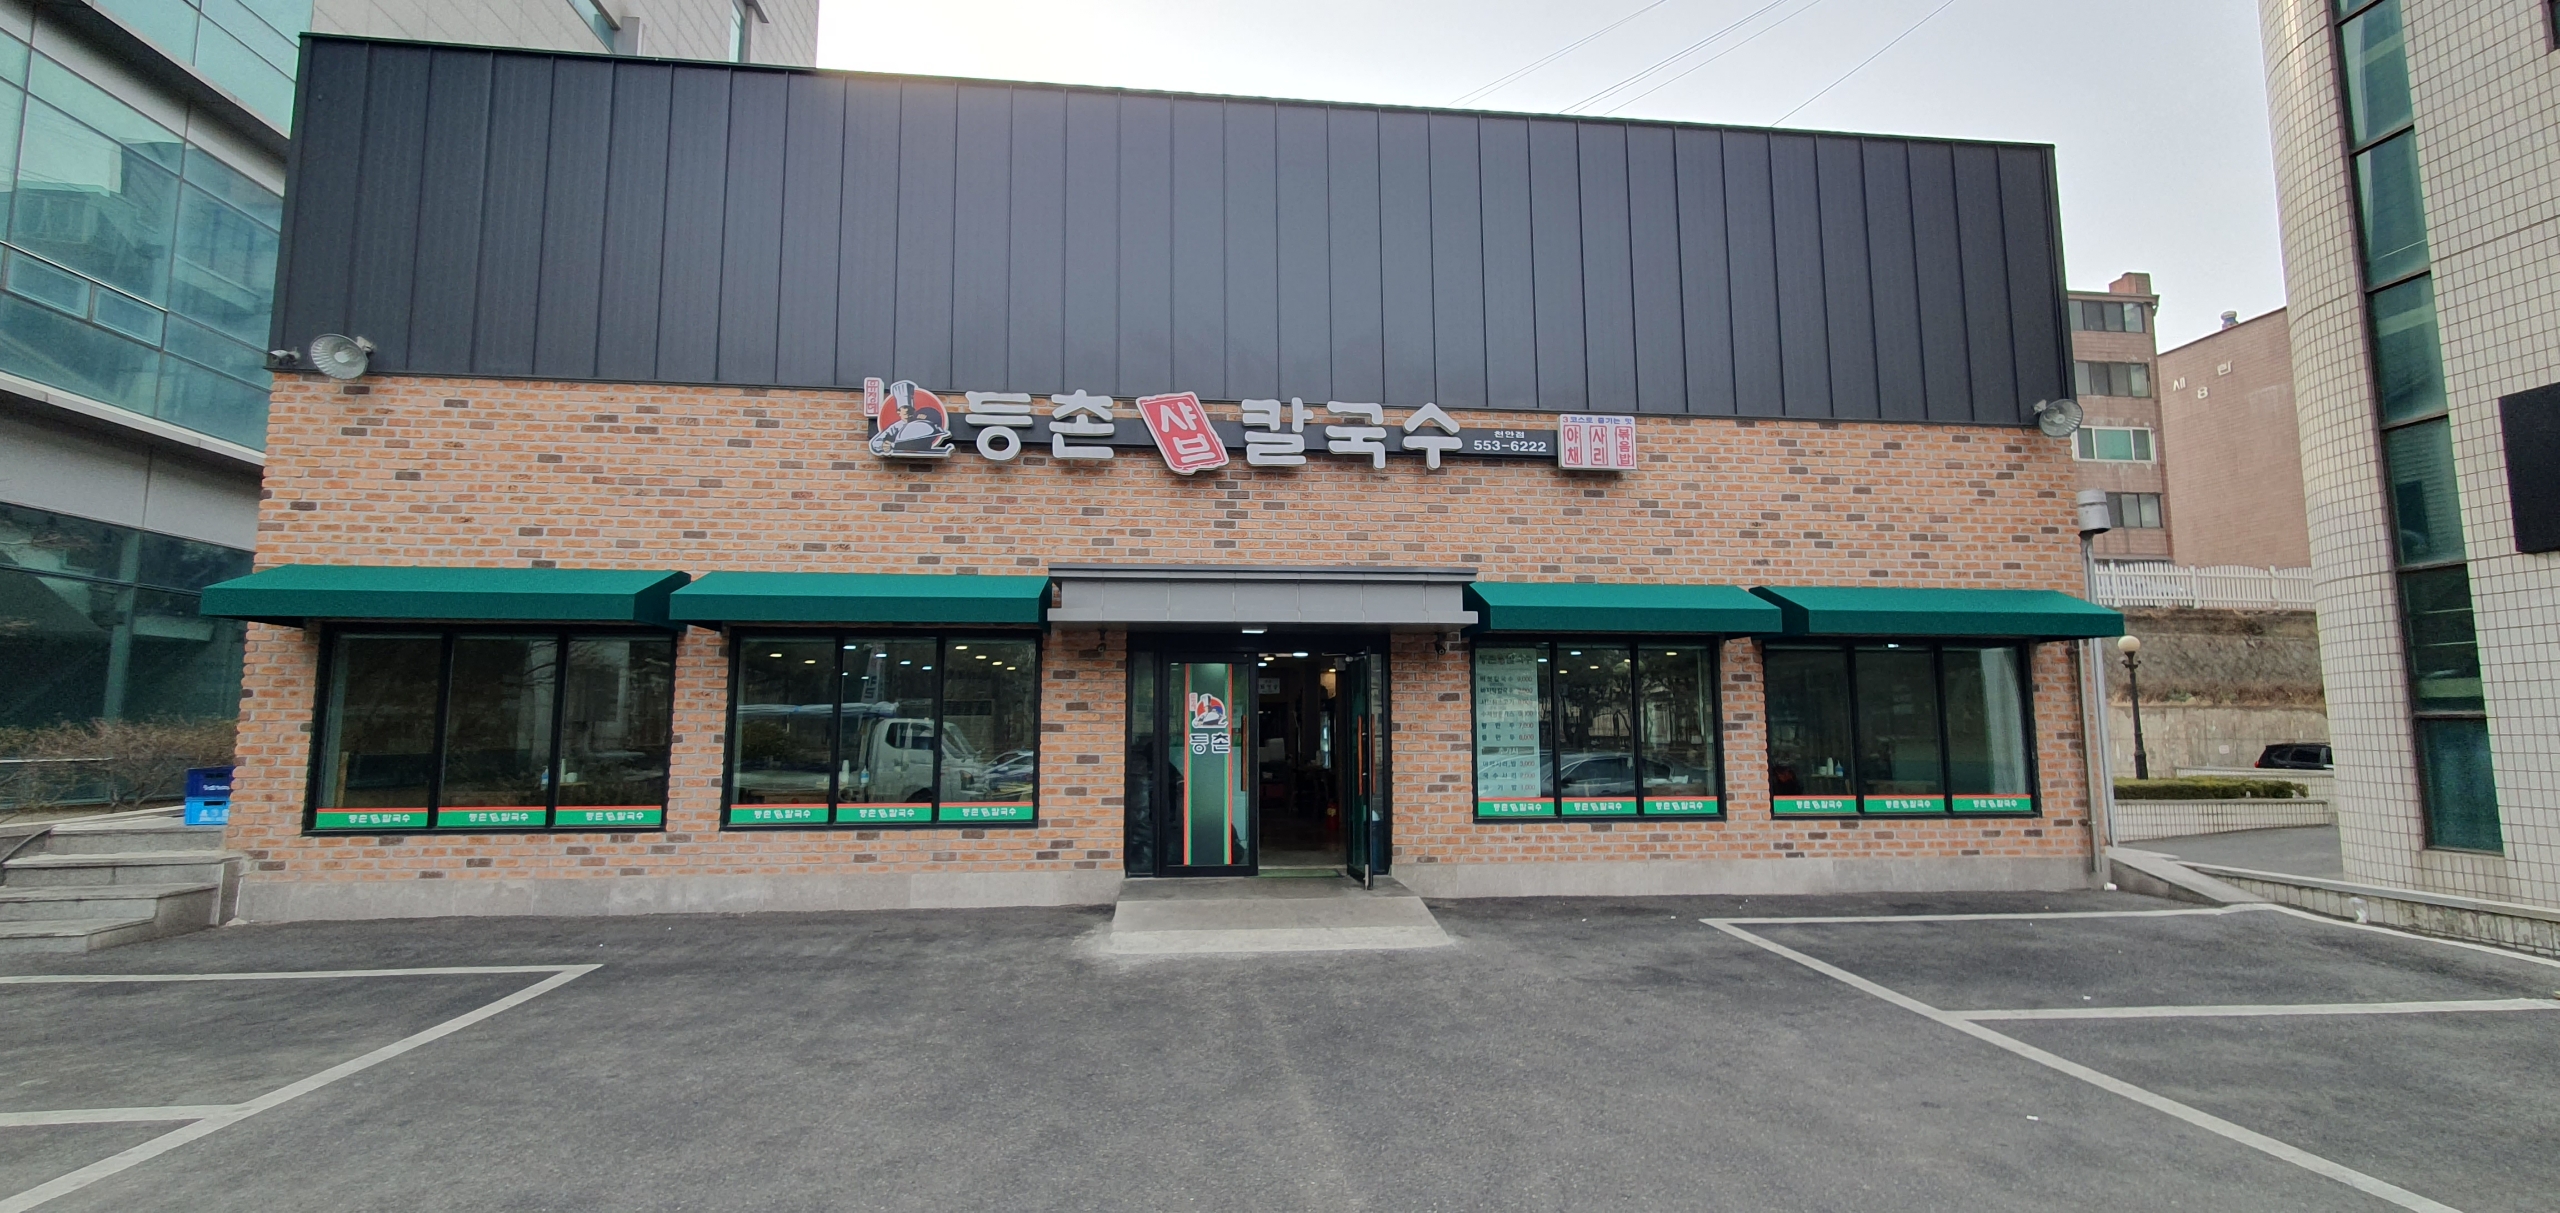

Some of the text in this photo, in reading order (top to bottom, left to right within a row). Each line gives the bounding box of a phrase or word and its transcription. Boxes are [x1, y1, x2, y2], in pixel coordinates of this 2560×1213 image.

[964, 389, 1463, 470] 등촌 샤브 칼국수
[1473, 440, 1547, 453] 553-6222
[1493, 430, 1525, 439] 천안점
[1566, 426, 1579, 464] 야채
[1592, 427, 1606, 464] 사리
[1618, 428, 1632, 465] 볶음밥
[1190, 732, 1231, 754] 등촌
